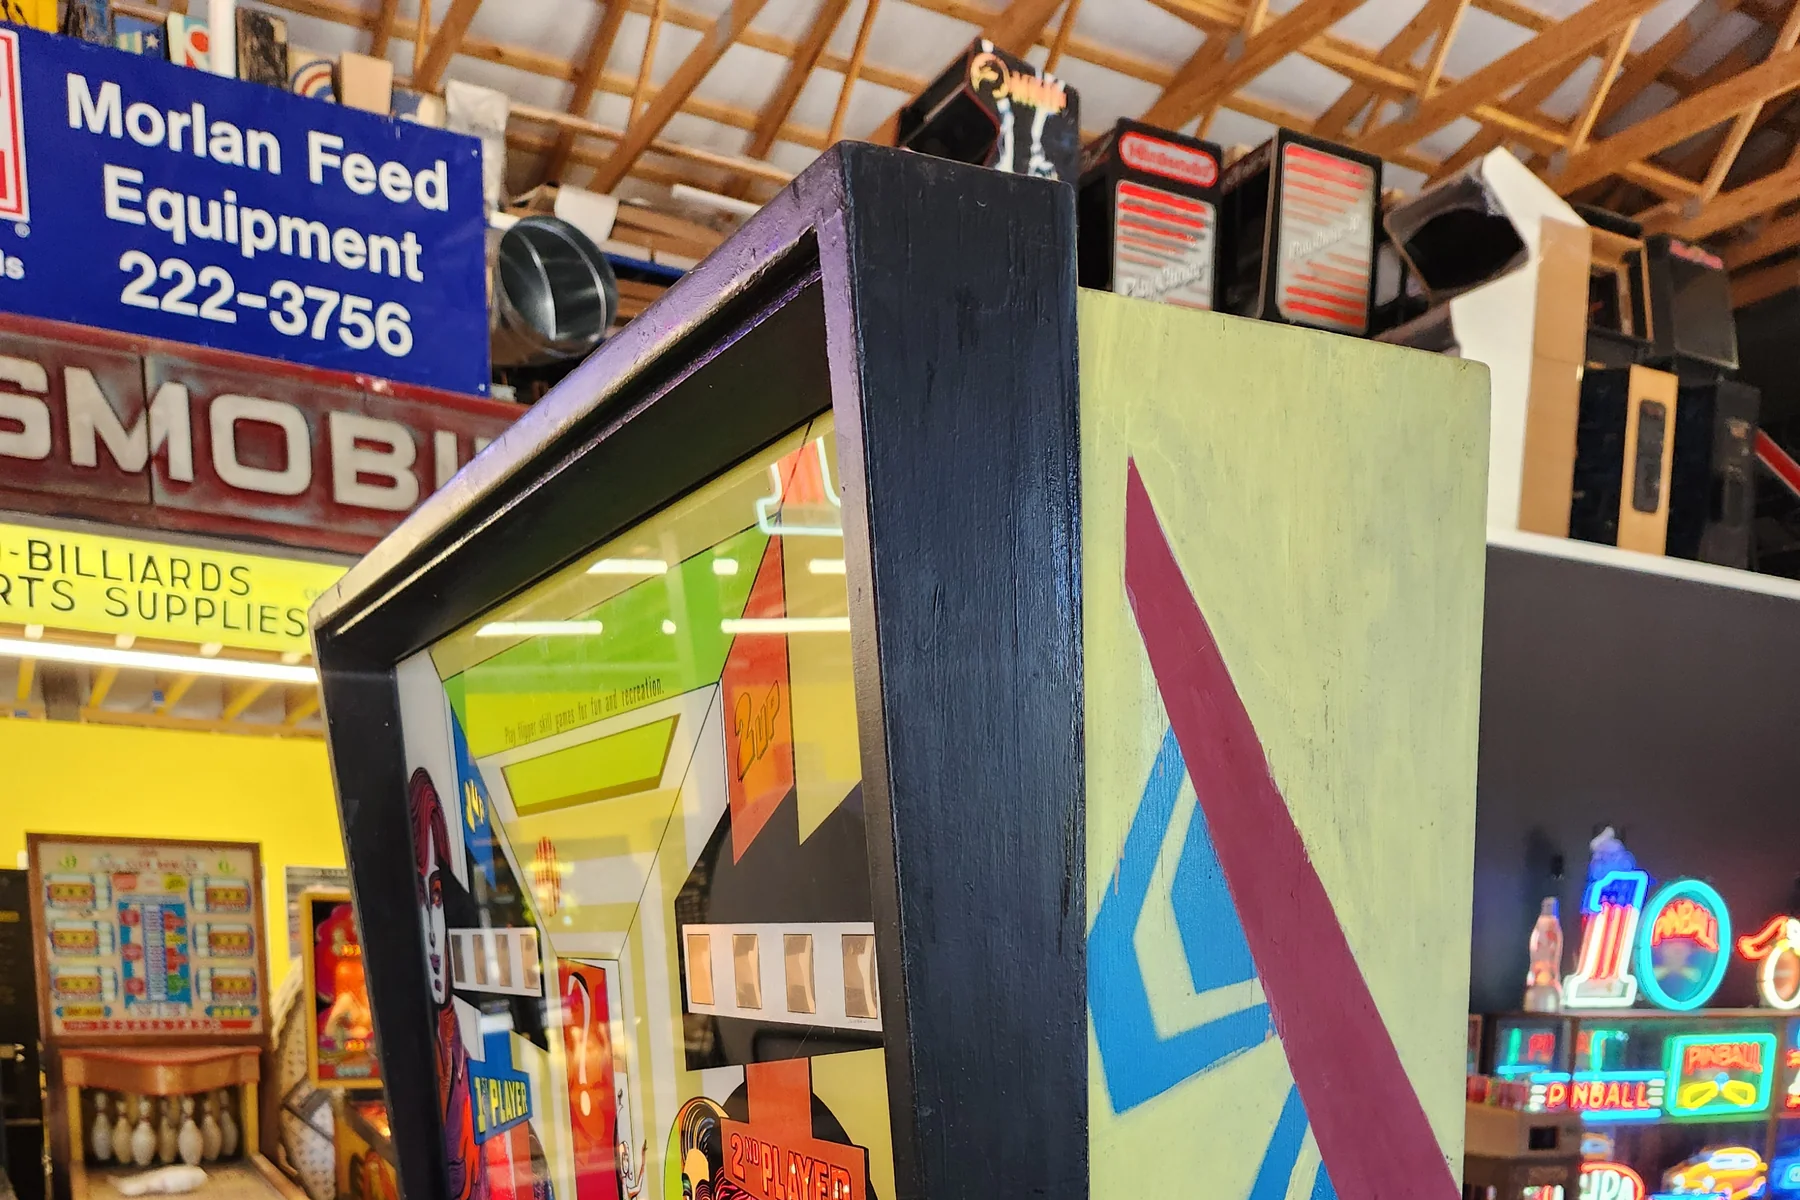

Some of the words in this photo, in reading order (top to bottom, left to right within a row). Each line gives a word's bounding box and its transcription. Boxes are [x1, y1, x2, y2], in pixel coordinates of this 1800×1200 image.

[66, 72, 282, 175] Morlan
[307, 129, 449, 212] Feed
[103, 163, 424, 283] Equipment
[119, 249, 414, 358] 222-3756
[0, 355, 492, 512] SMOBI
[104, 586, 306, 638] SUPPLIES
[555, 707, 576, 734] games
[578, 700, 588, 721] for
[591, 696, 602, 716] fun
[605, 688, 618, 713] and
[1683, 1042, 1763, 1075] PINBALL
[489, 1078, 529, 1129] PLAYER
[1546, 1080, 1650, 1110] PNBALL
